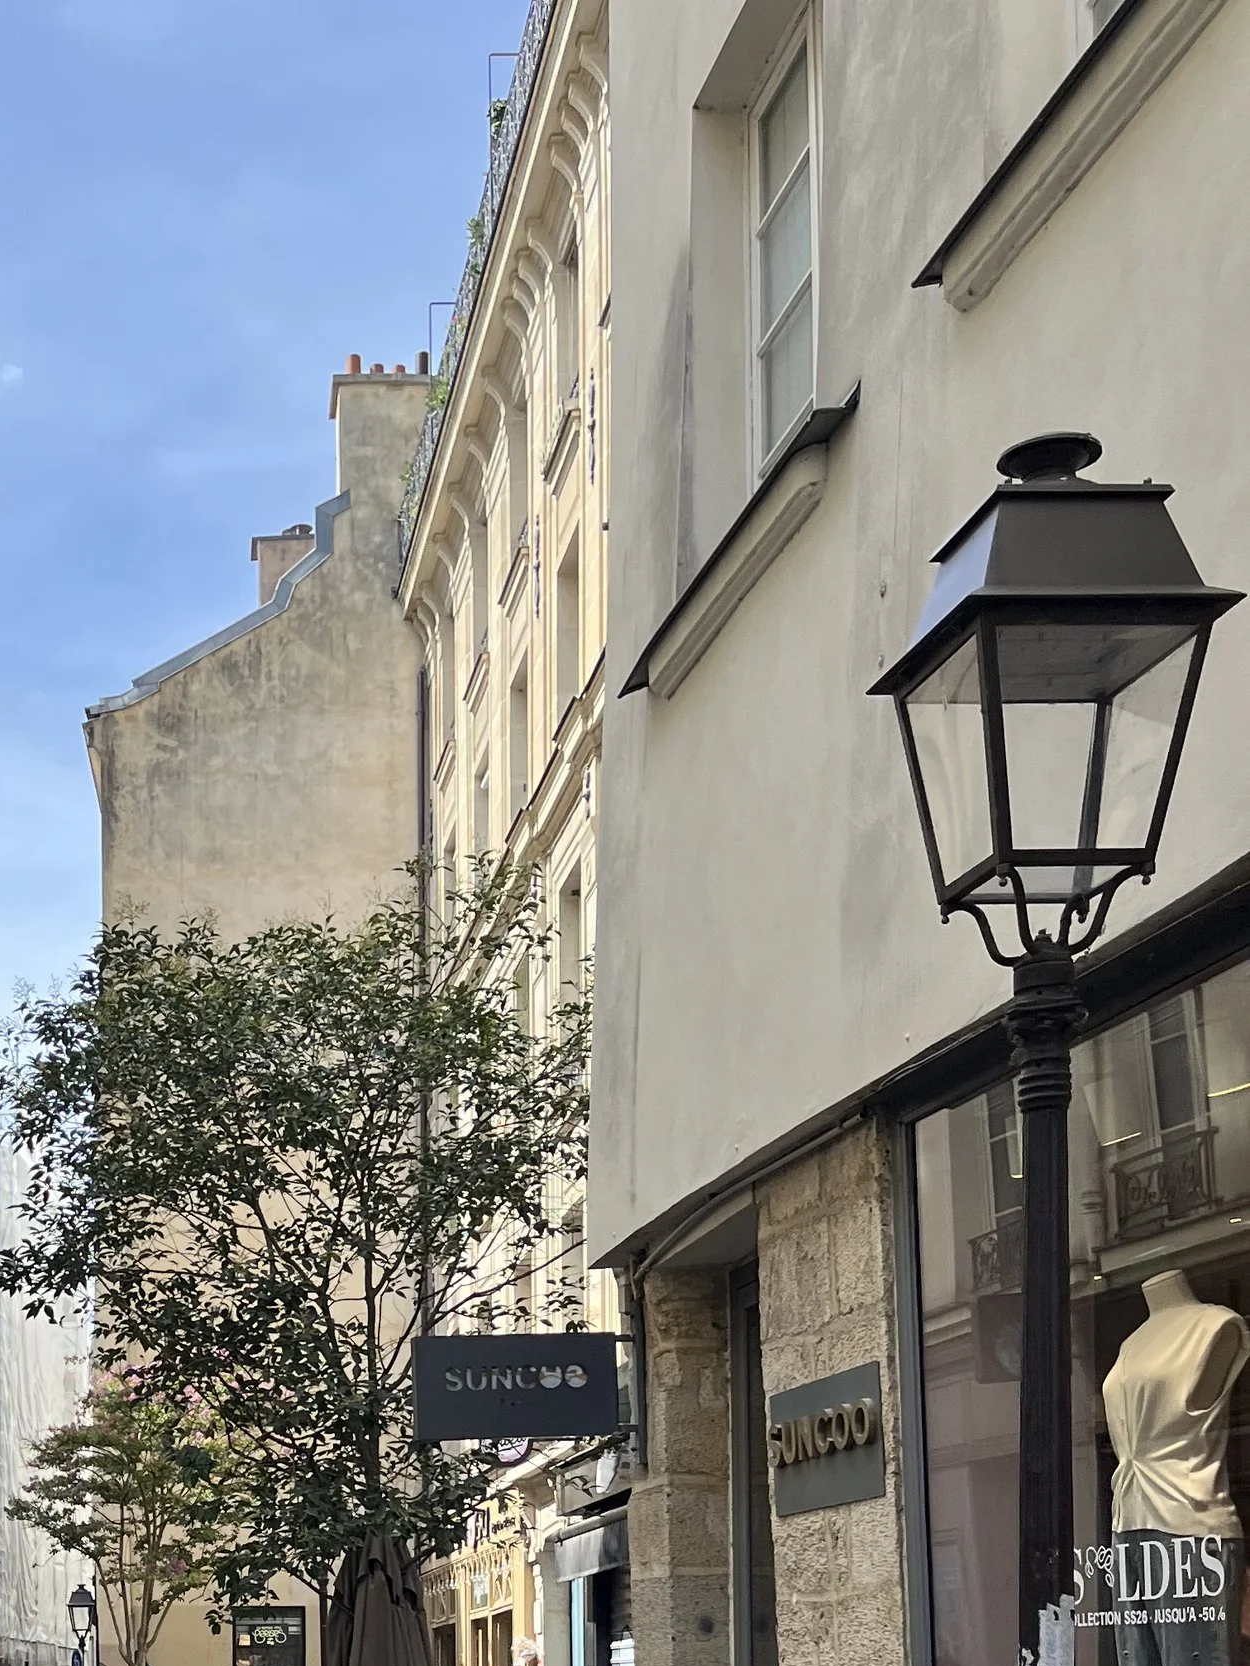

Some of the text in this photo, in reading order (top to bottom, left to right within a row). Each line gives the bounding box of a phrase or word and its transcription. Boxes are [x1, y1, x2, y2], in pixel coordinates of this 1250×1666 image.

[767, 1398, 874, 1468] SUNCOO
[1074, 1611, 1121, 1627] LLECTION
[1124, 1609, 1148, 1625] SS26
